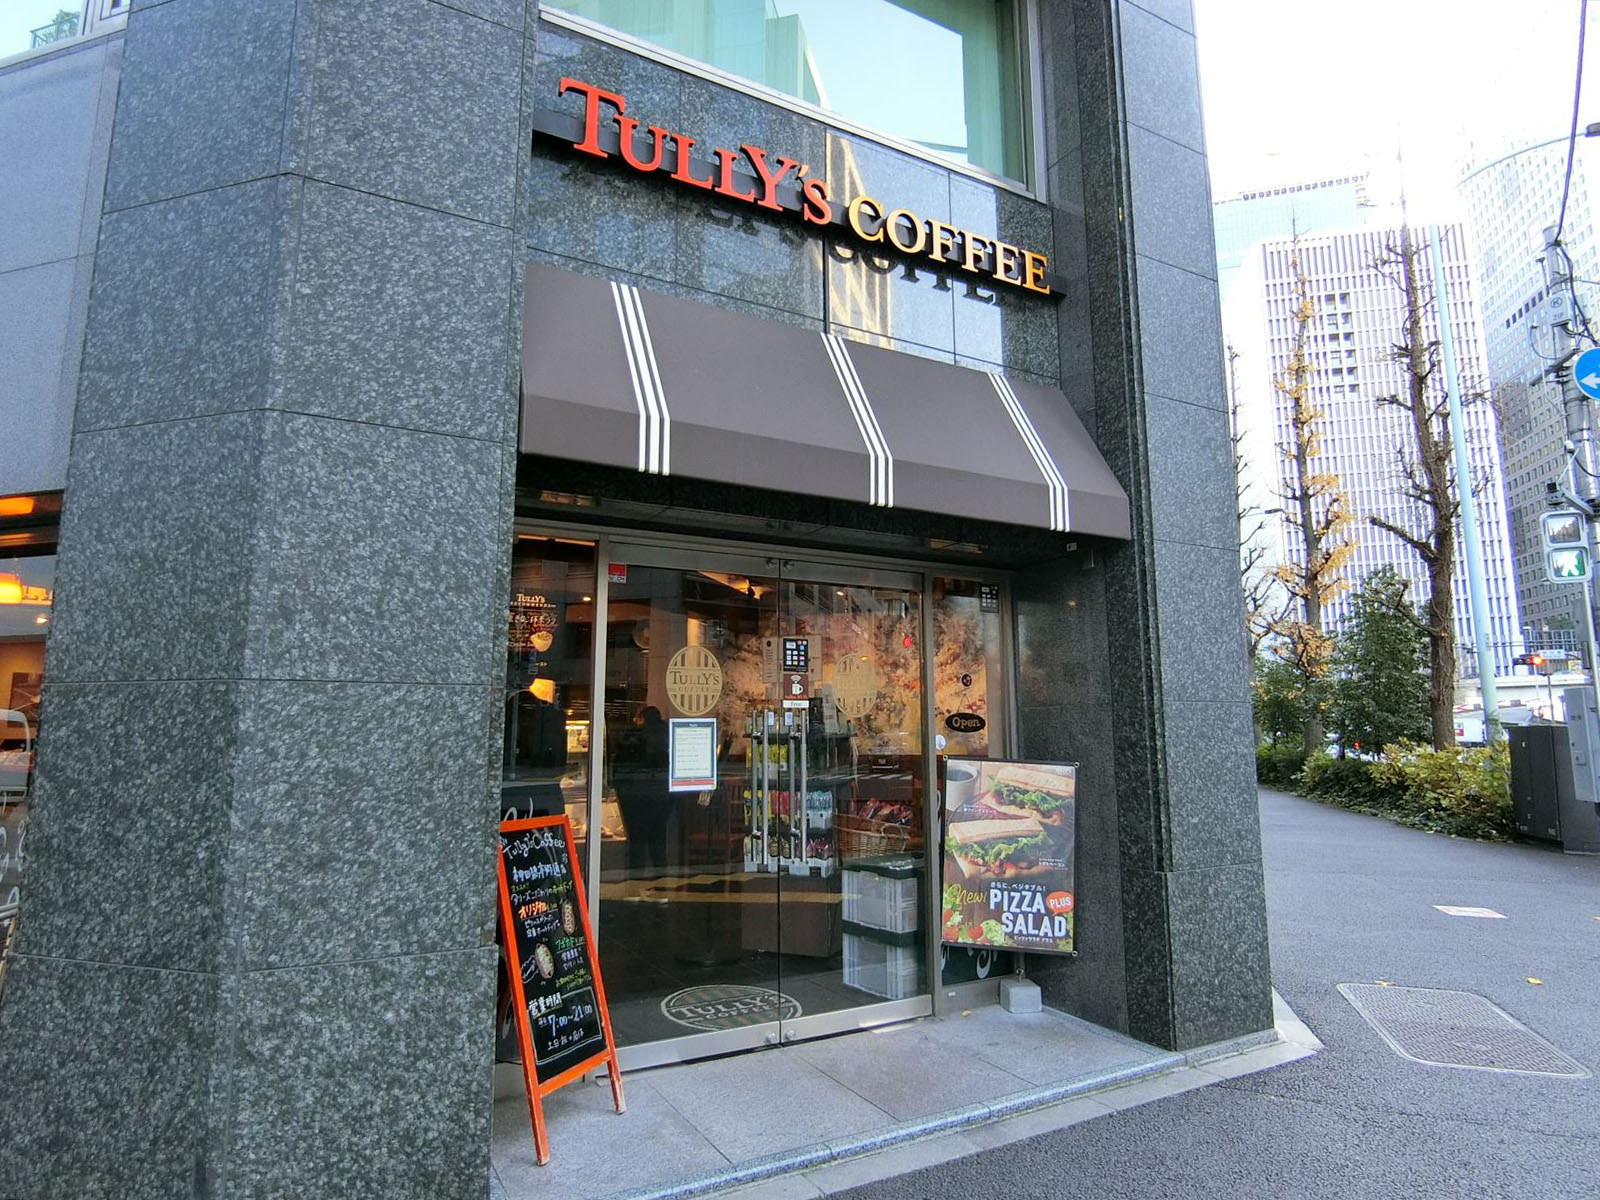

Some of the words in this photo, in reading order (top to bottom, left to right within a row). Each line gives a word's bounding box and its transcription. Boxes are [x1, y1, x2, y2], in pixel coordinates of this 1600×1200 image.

[558, 76, 833, 226] TULLY'S
[847, 195, 1051, 295] COFFEE
[669, 671, 720, 685] TULLY'S
[952, 716, 981, 729] Open
[989, 889, 1046, 914] PIZZA
[1049, 895, 1073, 909] PLUS
[1001, 913, 1067, 938] SALAD
[671, 995, 787, 1018] TULLY'S
[704, 1004, 774, 1020] COFFEE
